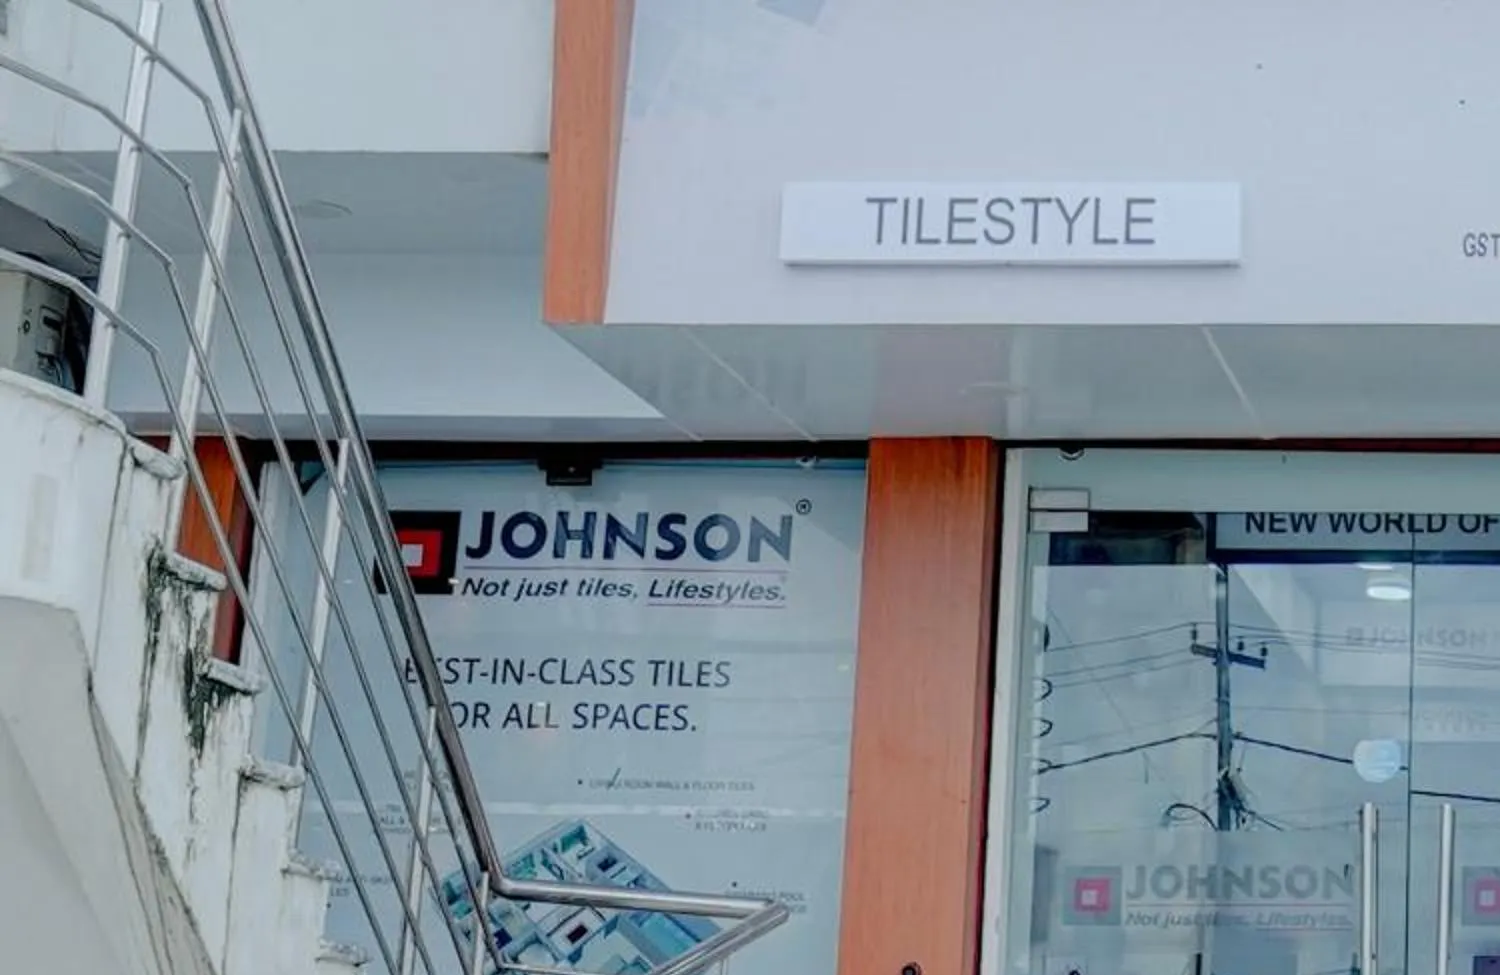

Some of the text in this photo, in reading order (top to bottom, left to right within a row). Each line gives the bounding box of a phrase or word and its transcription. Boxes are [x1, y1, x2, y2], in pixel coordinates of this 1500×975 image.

[866, 197, 1156, 245] TILESTYLE
[465, 510, 794, 562] JOHNSON
[1245, 512, 1500, 534] NEW WORLD OF
[461, 577, 786, 602] Not just tiles, Lifestyles.
[405, 657, 732, 688] BST-IN-CLASS TILES
[449, 702, 697, 732] OR ALL SPACES.
[1125, 863, 1355, 899] JOHNSON
